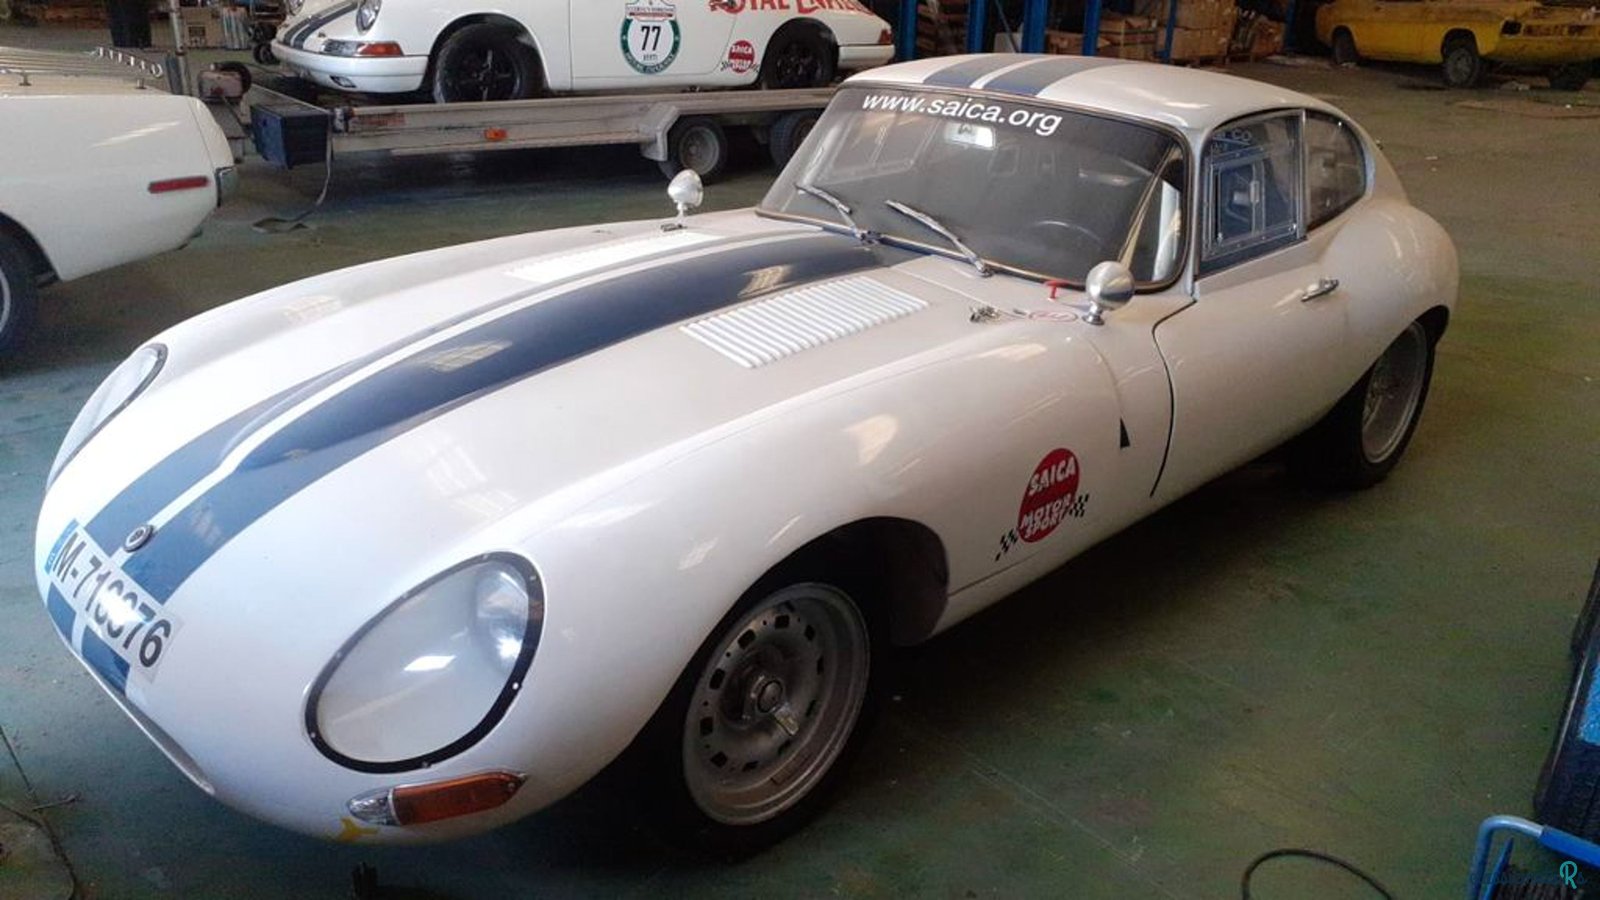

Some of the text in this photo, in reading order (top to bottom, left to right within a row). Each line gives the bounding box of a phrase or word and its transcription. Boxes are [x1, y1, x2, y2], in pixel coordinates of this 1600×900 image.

[641, 25, 661, 51] 77
[862, 94, 1063, 136] www.saica.org
[1028, 456, 1076, 496] SAICA
[1020, 493, 1072, 529] MOTOR
